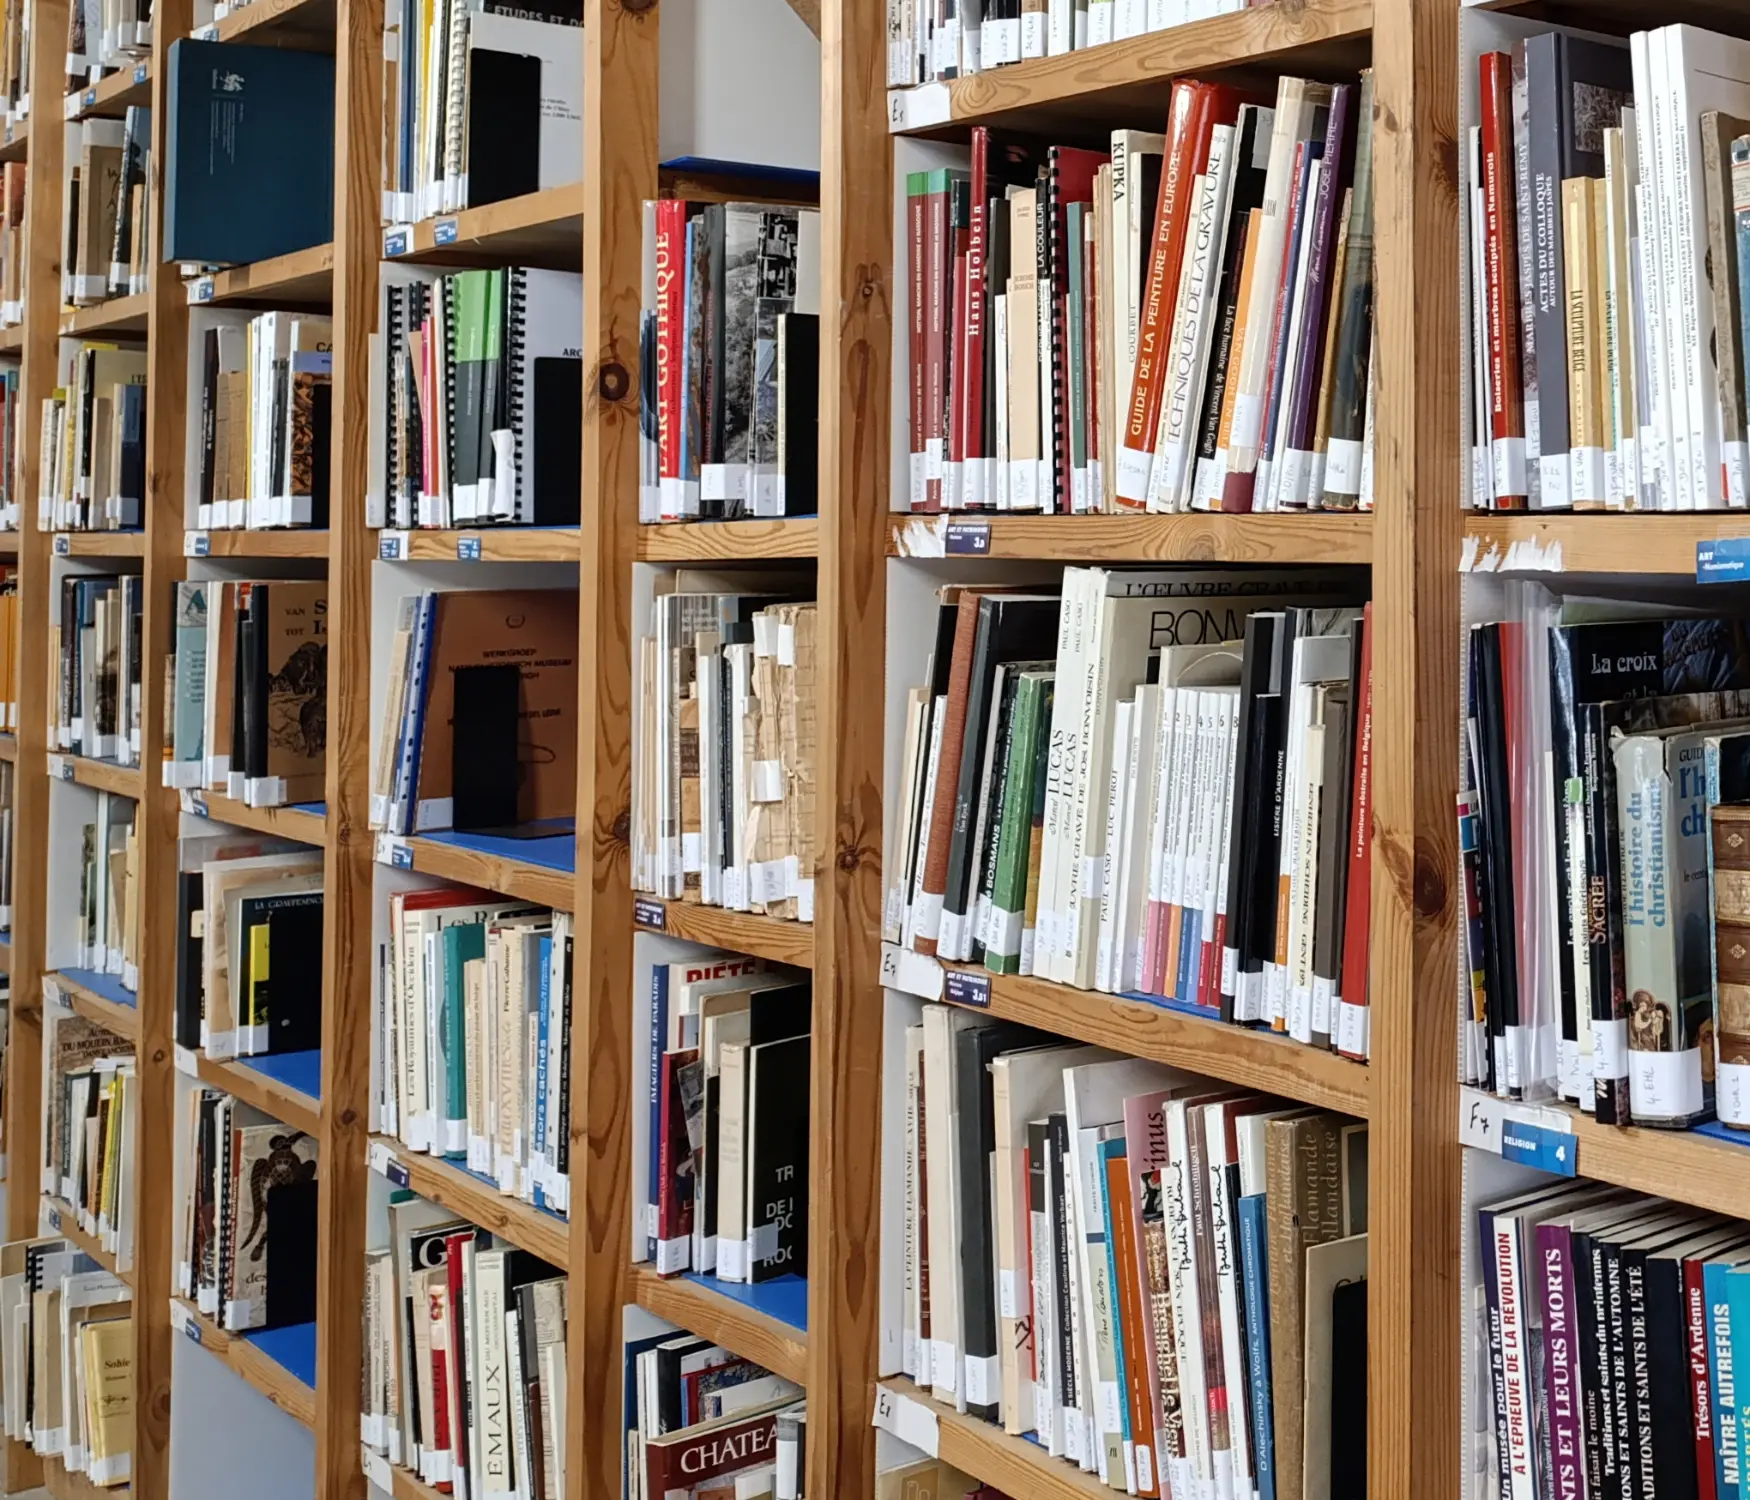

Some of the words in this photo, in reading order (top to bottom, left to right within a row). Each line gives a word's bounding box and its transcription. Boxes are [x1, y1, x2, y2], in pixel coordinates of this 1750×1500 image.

[1113, 142, 1125, 202] KUPKA
[1163, 152, 1180, 214] EUROPE
[1486, 151, 1495, 211] Namurois
[1196, 152, 1221, 250] GRAVURE
[1490, 215, 1496, 230] en
[1536, 172, 1547, 247] COLLOQUE
[969, 204, 982, 279] Holbein
[1158, 220, 1171, 242] EN
[1193, 255, 1208, 282] LA
[1489, 235, 1498, 284] sculptés
[1538, 249, 1547, 269] DU
[656, 232, 675, 386] GOTHIQUE
[968, 291, 980, 336] Hans
[1147, 249, 1166, 326] PEINTURE
[1187, 290, 1199, 313] DE
[1491, 286, 1500, 337] marbres
[1539, 272, 1549, 313] ACTES
[1138, 359, 1151, 379] DE
[1142, 332, 1155, 353] LA
[1493, 339, 1500, 351] et
[1131, 387, 1147, 435] GUIDE
[1492, 357, 1502, 412] Boiseries
[656, 398, 669, 473] L'ART
[1698, 551, 1714, 561] ART
[1591, 653, 1612, 674] La
[1617, 651, 1658, 672] croix
[1048, 729, 1063, 795] LUCAS
[1062, 733, 1077, 798] LUCAS
[1625, 792, 1643, 820] du
[986, 825, 1002, 889] BOSMANS
[1625, 827, 1645, 926] l'histoire
[1590, 876, 1607, 944] SACRÉE
[1503, 1135, 1536, 1151] RELIGION
[1555, 1145, 1566, 1162] 4
[1497, 1233, 1514, 1318] RÉVOLUTION
[1546, 1249, 1565, 1332] MORTS
[1490, 1307, 1501, 1349] futur
[1608, 1259, 1623, 1350] L'AUTOMNE
[1689, 1288, 1707, 1374] d'Ardenne
[1492, 1353, 1503, 1370] le
[1505, 1331, 1517, 1348] LA
[1506, 1352, 1518, 1372] DE
[1614, 1356, 1625, 1376] DE
[1713, 1303, 1735, 1407] AUTREFOIS
[1496, 1373, 1509, 1415] pour
[1552, 1338, 1570, 1417] LEURS
[486, 1364, 503, 1477] EMAUX
[1256, 1392, 1269, 1471] D'Alechinsky
[1508, 1378, 1524, 1460] L'ÉPREUVE
[1616, 1382, 1628, 1437] SAINTS
[1696, 1381, 1710, 1440] Trésors
[1497, 1417, 1509, 1474] musée
[1557, 1424, 1573, 1456] ET
[1619, 1442, 1630, 1462] ET
[1719, 1414, 1740, 1484] NAÎTRE
[1500, 1478, 1511, 1500] Un
[1513, 1464, 1525, 1475] À
